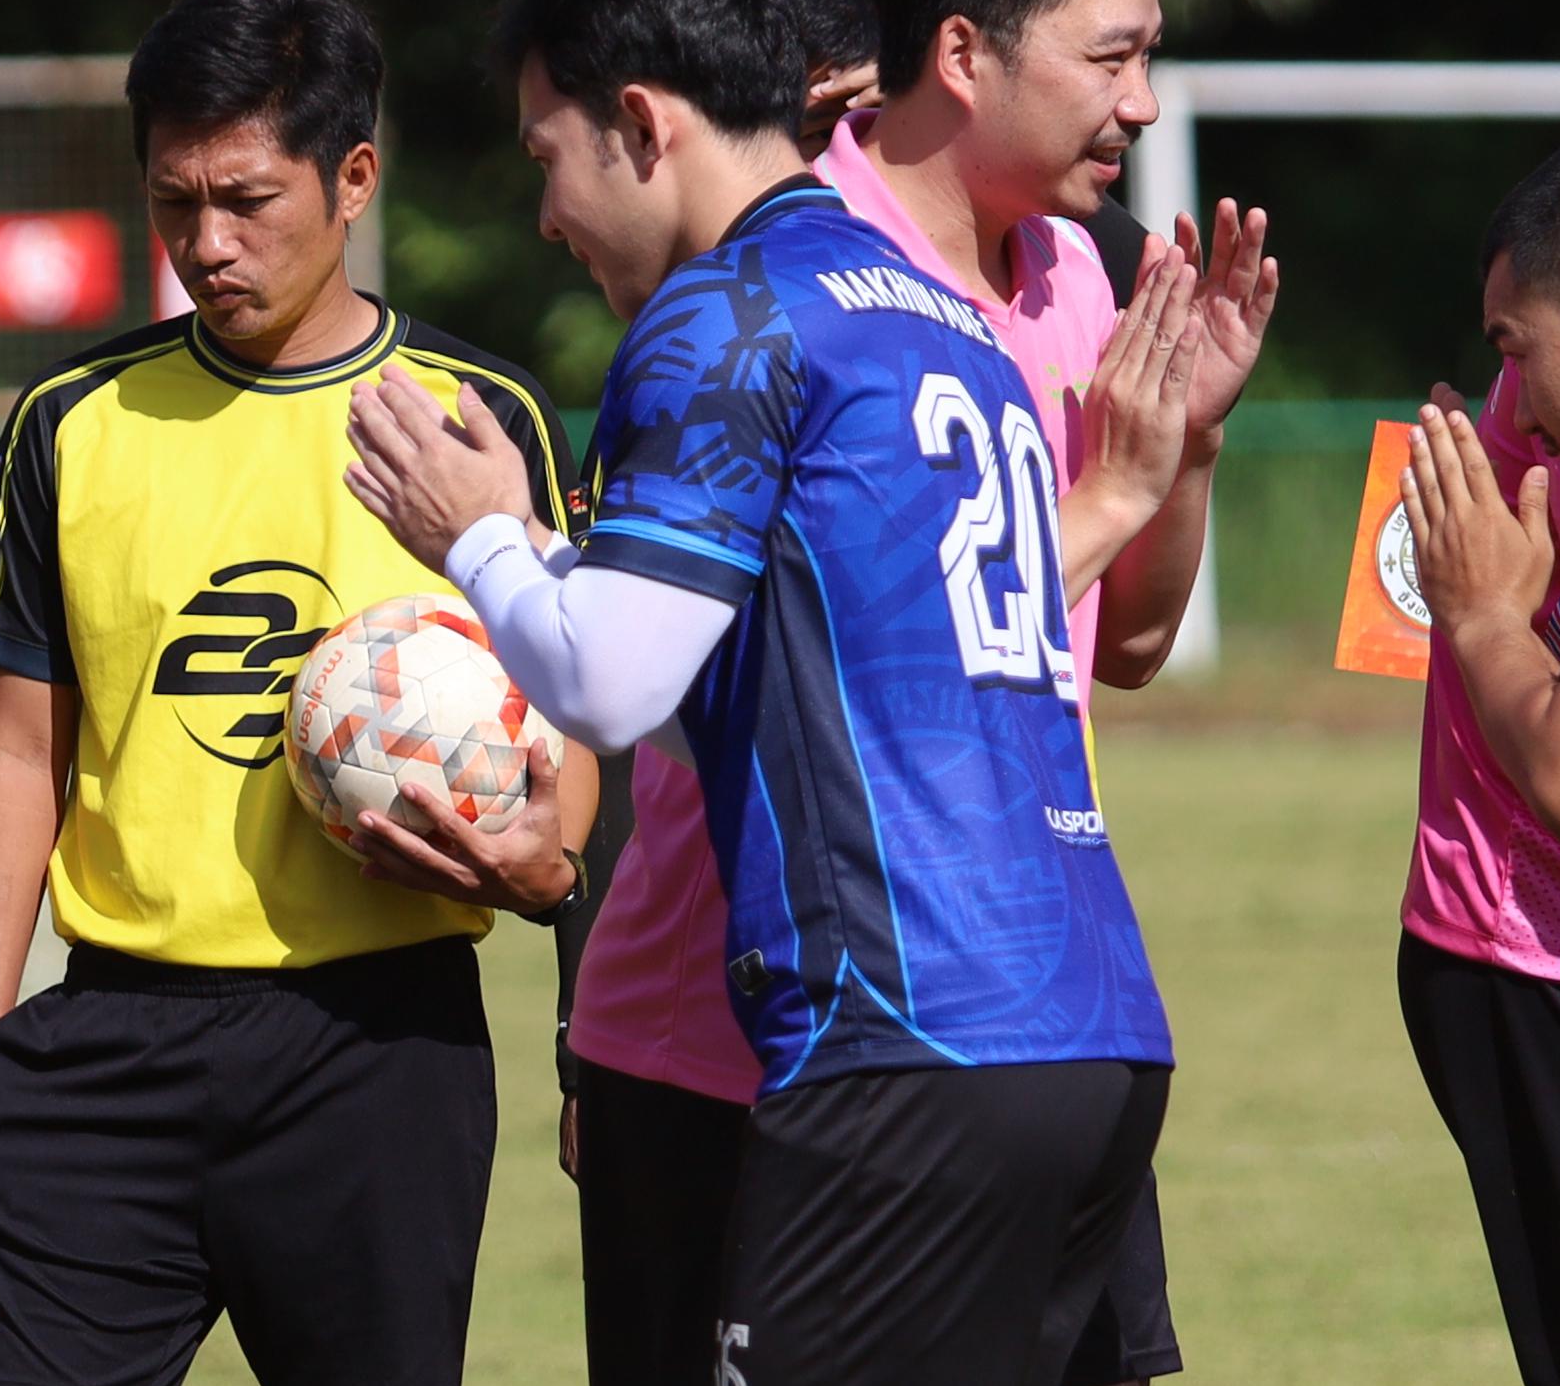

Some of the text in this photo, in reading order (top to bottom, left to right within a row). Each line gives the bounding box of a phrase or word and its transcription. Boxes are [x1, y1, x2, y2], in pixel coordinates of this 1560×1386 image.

[816, 266, 944, 323] NAKHON
[912, 373, 1079, 703] 20
[298, 650, 343, 745] molten
